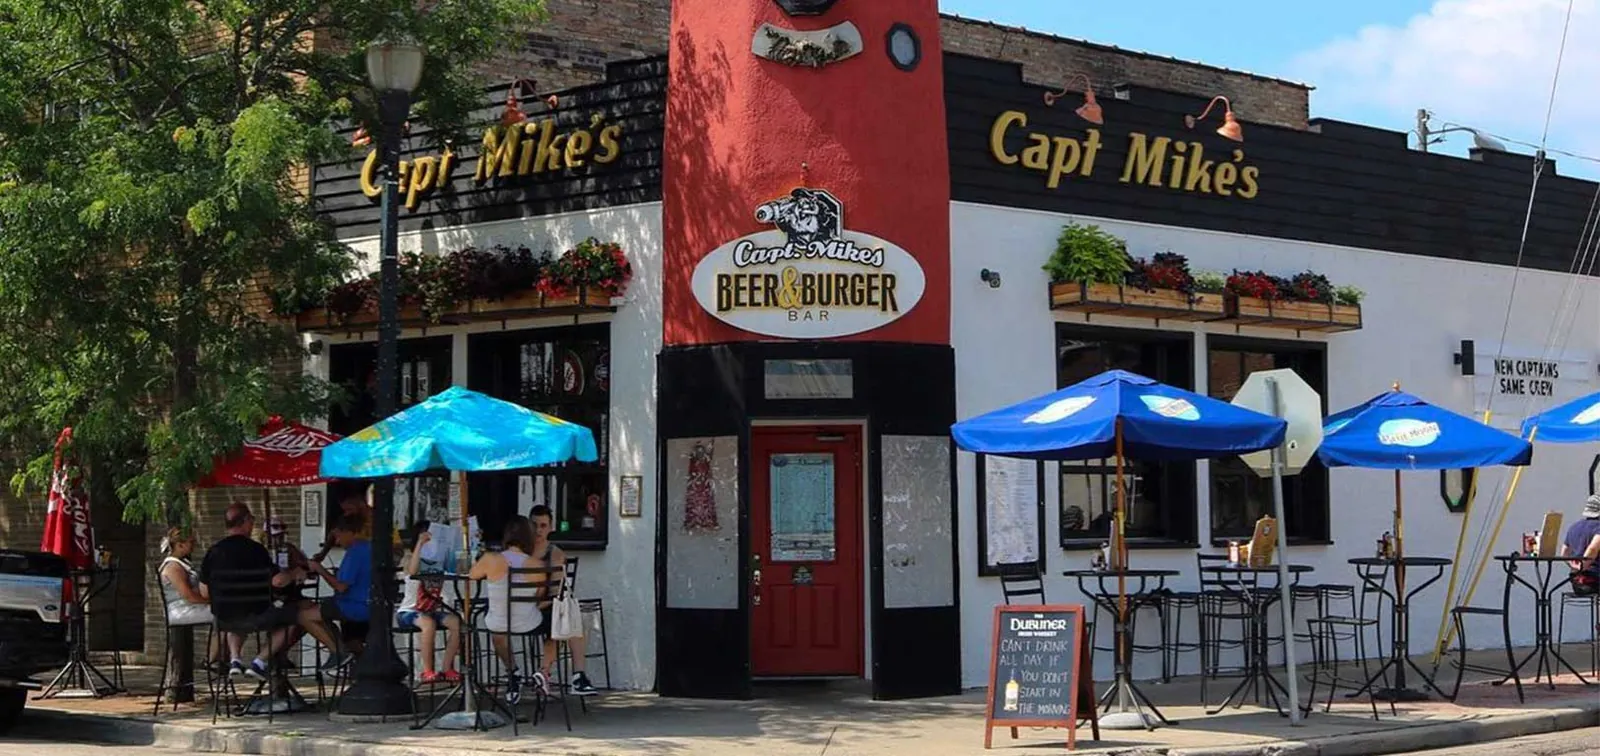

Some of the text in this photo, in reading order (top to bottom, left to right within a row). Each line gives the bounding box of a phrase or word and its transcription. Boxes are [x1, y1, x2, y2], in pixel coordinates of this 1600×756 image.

[475, 112, 622, 184] Mike's
[990, 110, 1260, 199] Capt Mike's
[805, 239, 885, 267] Mikes
[787, 310, 830, 322] BAR
[1500, 378, 1525, 394] SAME
[233, 473, 255, 481] JOIN
[299, 474, 319, 483] HER
[1001, 639, 1069, 652] CAN'T DRINK
[1000, 654, 1061, 667] ALL DAY IF
[1020, 670, 1068, 684] YOU DON'T
[1019, 687, 1062, 699] START IN
[1018, 703, 1071, 715] THE MORNING
